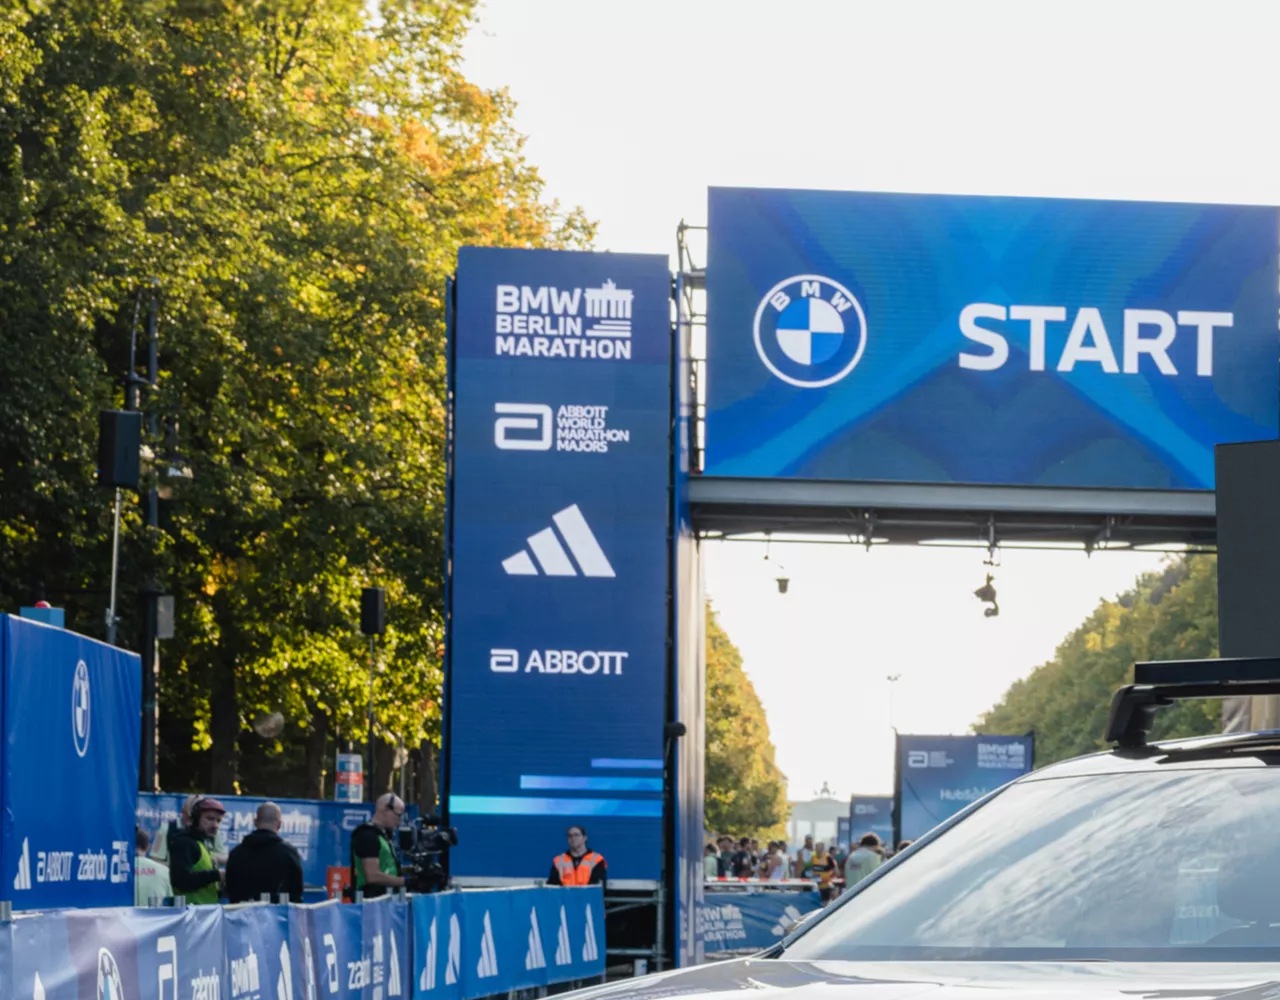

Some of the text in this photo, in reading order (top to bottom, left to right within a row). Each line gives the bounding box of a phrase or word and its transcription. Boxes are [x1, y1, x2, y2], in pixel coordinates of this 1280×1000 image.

[496, 285, 582, 315] BMW
[770, 281, 851, 313] BMW
[496, 314, 582, 336] BERLIN
[495, 336, 631, 360] MARATHON
[959, 303, 1234, 376] START
[557, 405, 608, 419] ABBOTT
[557, 418, 606, 429] WORLD
[557, 429, 630, 442] MARATHON
[557, 440, 609, 452] MAJORS
[524, 649, 629, 675] ABBOTT
